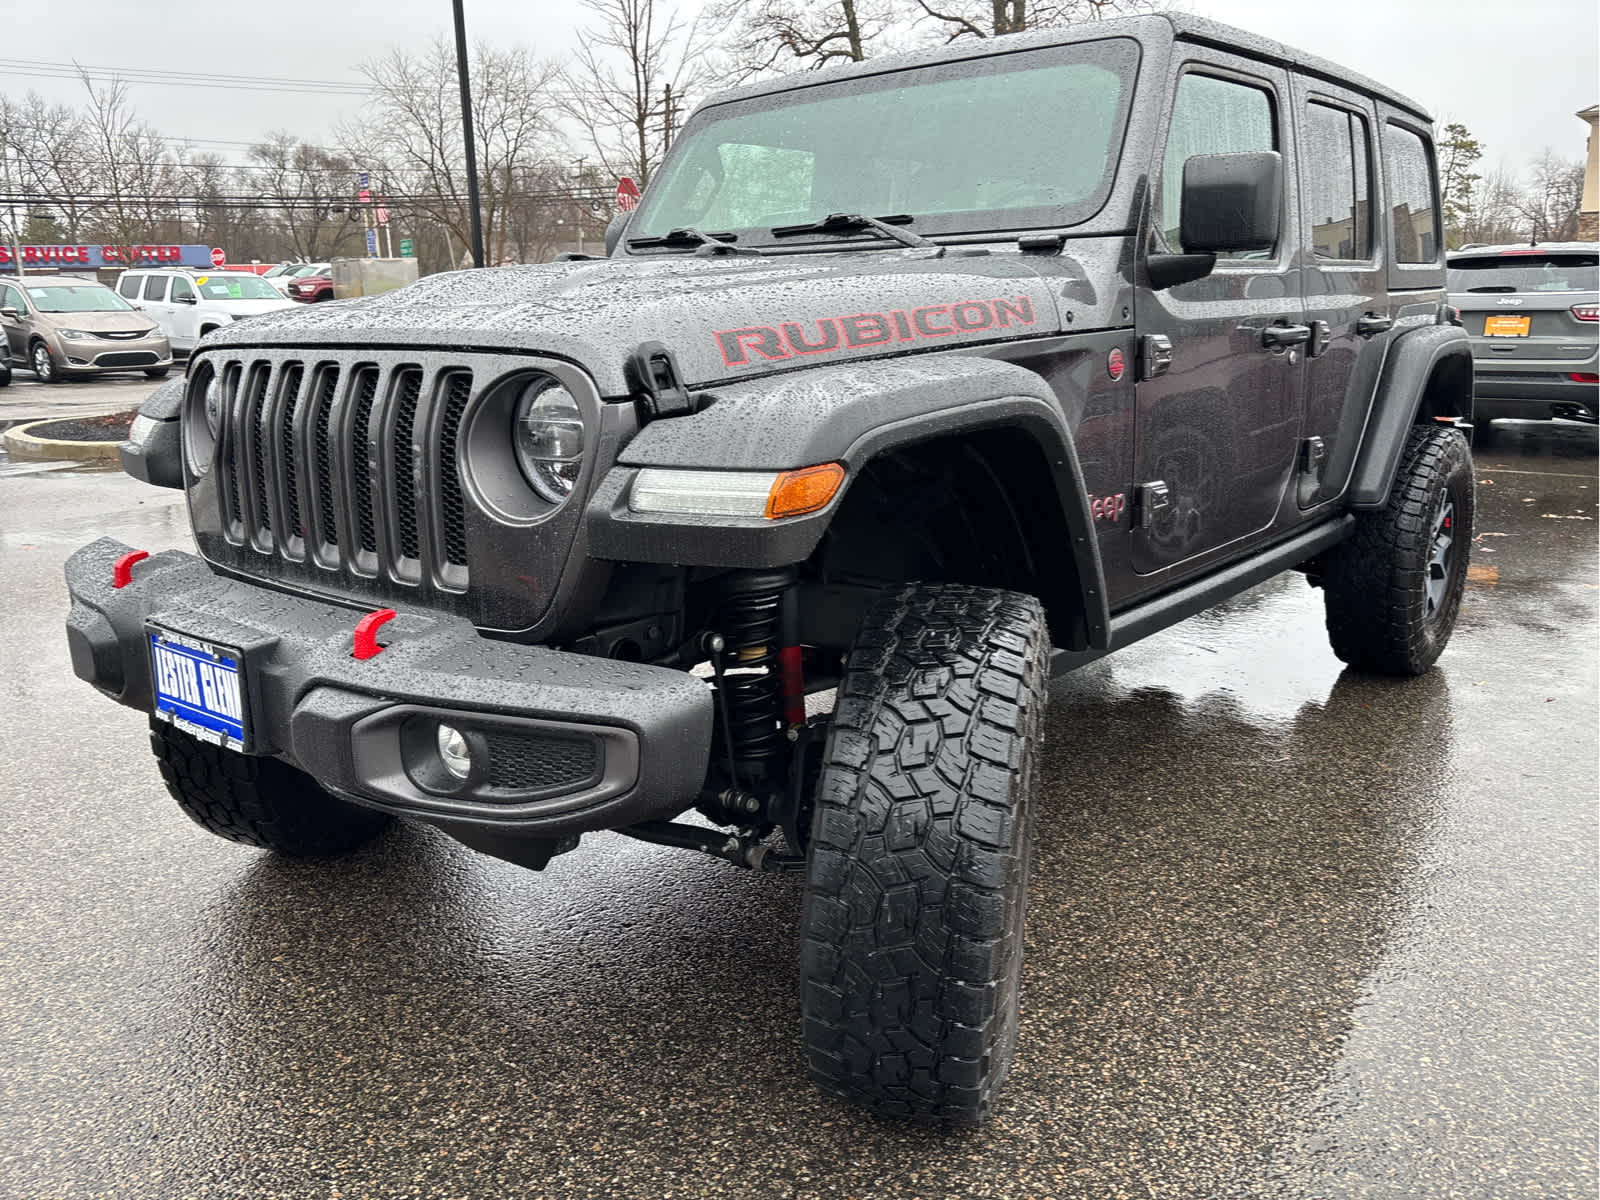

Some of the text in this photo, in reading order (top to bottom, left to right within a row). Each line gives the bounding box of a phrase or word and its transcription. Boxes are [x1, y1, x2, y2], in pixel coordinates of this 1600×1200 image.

[1495, 297, 1523, 306] Jeep
[713, 296, 1036, 367] RUBICON
[1088, 493, 1125, 522] eep
[155, 646, 243, 721] LESTER GLENN
